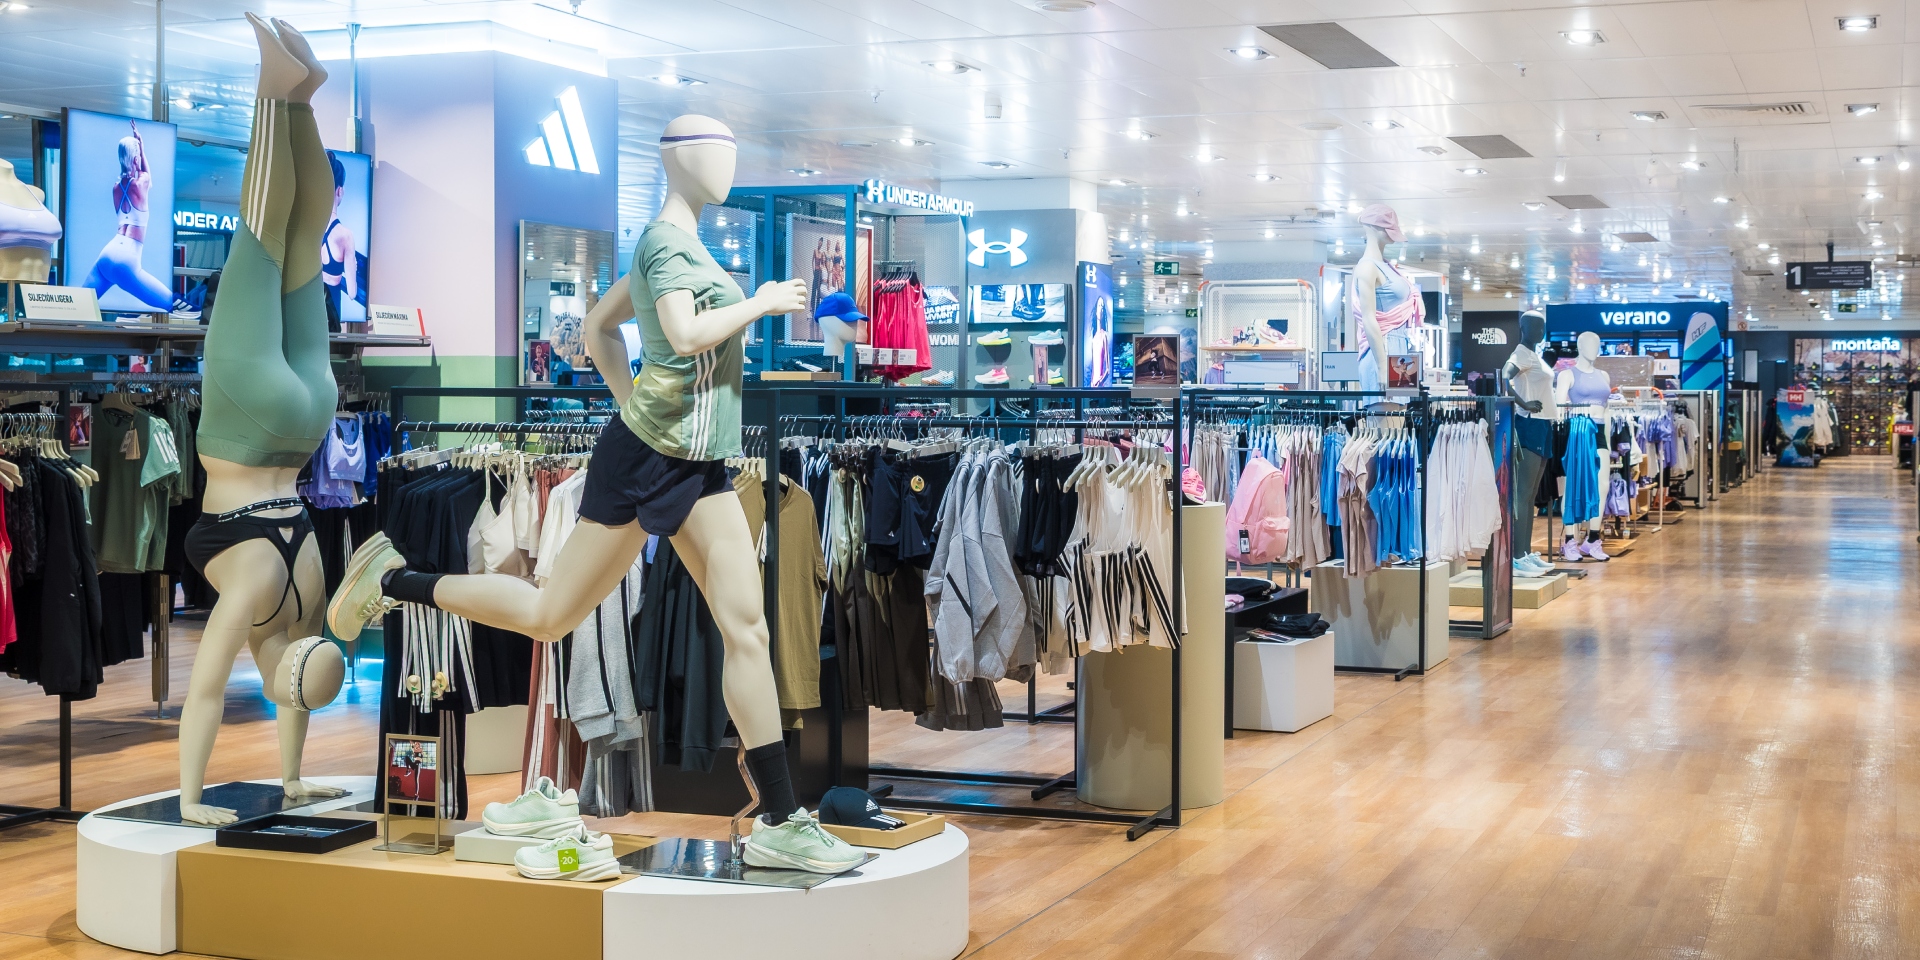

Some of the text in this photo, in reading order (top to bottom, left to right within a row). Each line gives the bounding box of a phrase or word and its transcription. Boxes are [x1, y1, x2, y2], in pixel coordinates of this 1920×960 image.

[886, 185, 974, 217] UNDER ARMOUR
[173, 210, 218, 229] NDER
[1791, 266, 1801, 285] 1
[27, 292, 74, 304] SUJECIÓN LIGERA
[1600, 310, 1671, 325] verano
[1831, 337, 1900, 351] montaña
